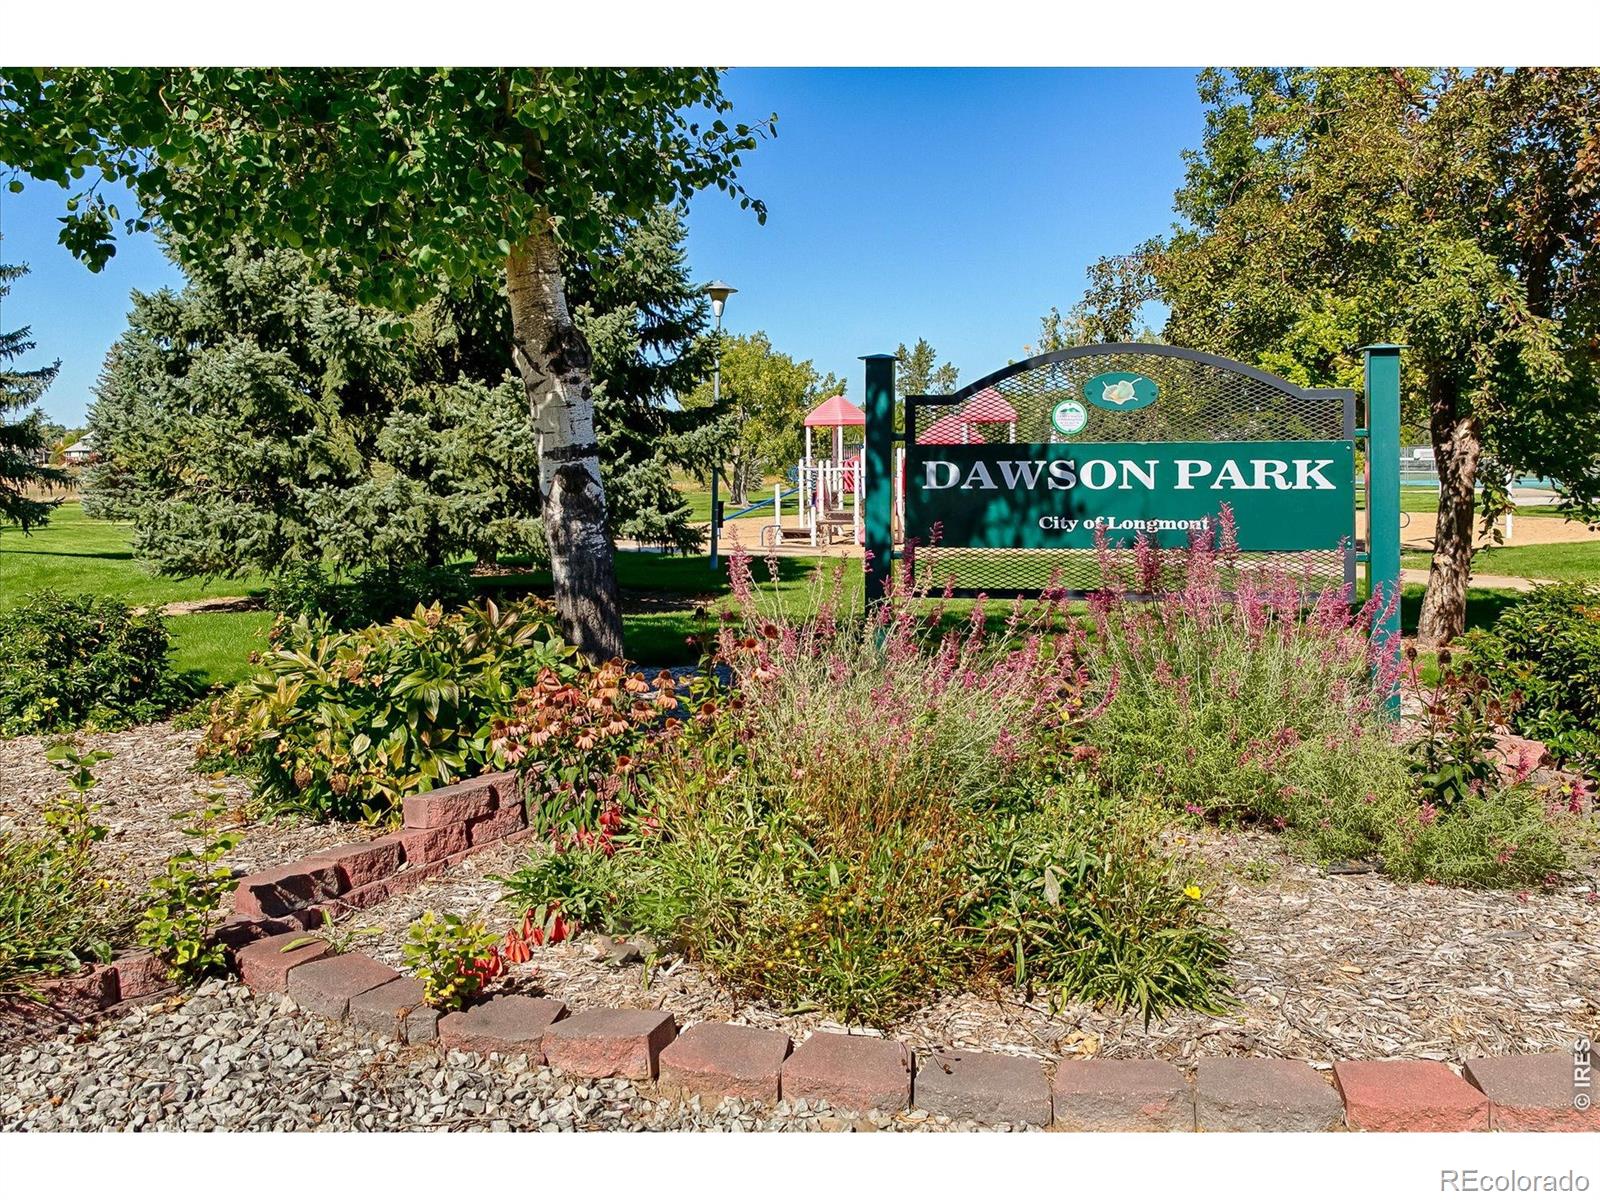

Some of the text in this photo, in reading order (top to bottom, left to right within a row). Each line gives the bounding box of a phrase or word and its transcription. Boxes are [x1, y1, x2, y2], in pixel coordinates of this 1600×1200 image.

[921, 459, 1337, 490] DAWSON PARK
[1038, 515, 1210, 533] City of Longmont
